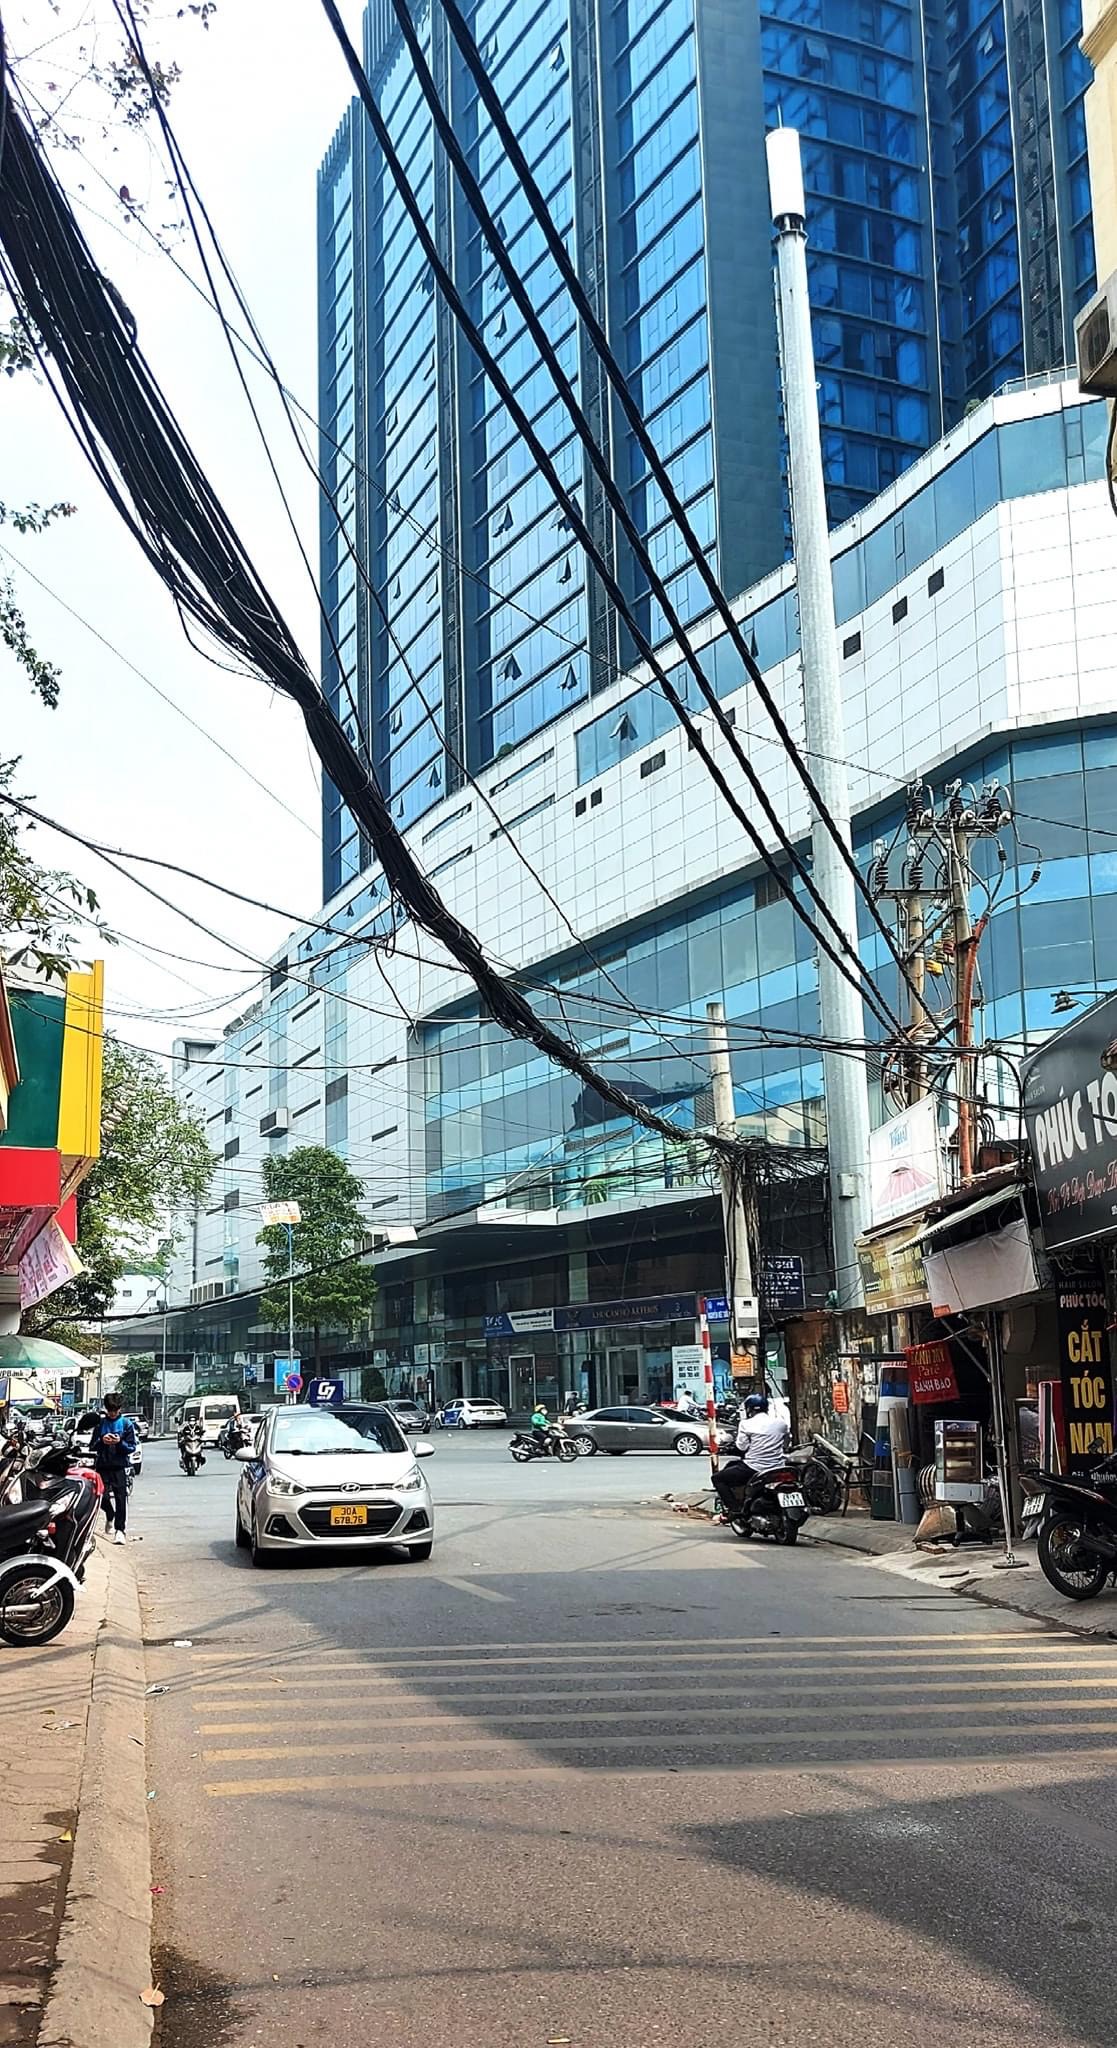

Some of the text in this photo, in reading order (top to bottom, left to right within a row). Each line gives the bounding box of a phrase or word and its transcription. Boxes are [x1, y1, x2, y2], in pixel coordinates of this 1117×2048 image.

[1035, 1085, 1088, 1172] PHÚC
[1067, 1319, 1102, 1363] CẮT
[317, 1381, 336, 1400] G7
[1070, 1370, 1106, 1409] TÓC
[1069, 1422, 1114, 1454] NAM
[334, 1516, 363, 1524] 678.76
